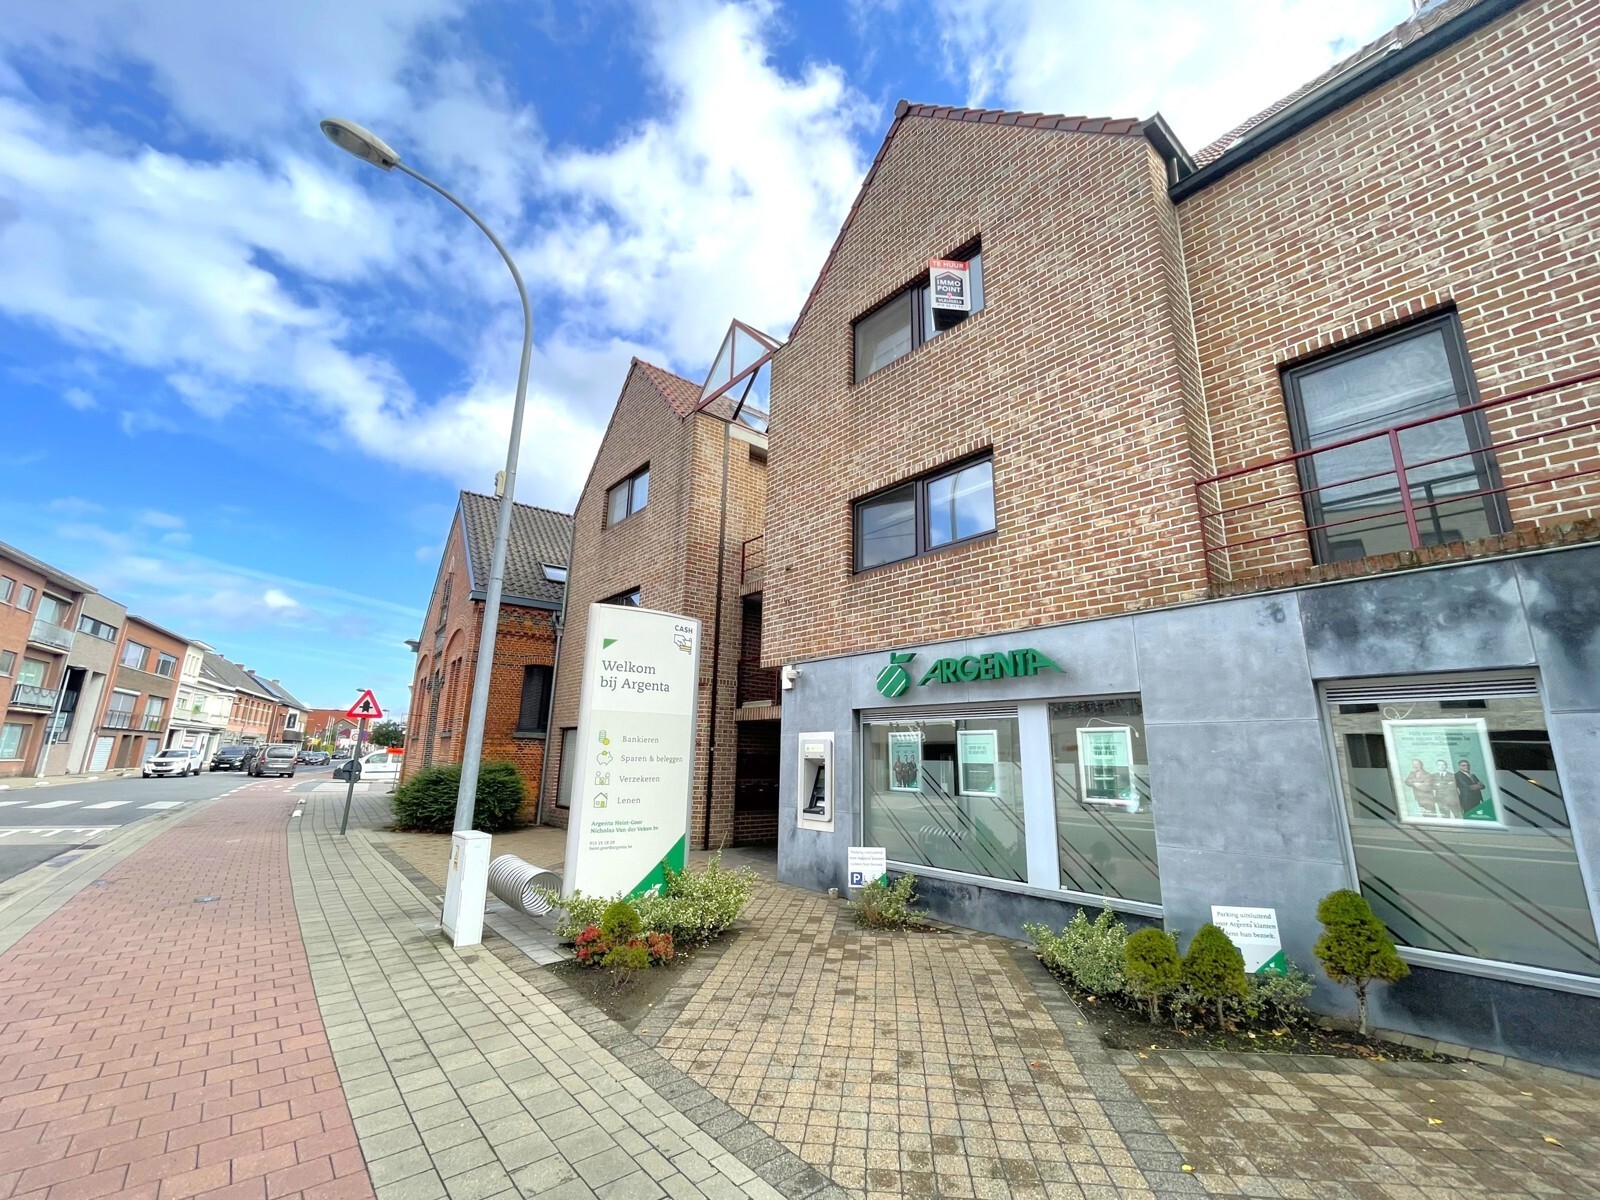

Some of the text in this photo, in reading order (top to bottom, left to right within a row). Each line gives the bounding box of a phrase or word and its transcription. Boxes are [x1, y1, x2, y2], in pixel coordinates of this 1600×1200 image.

[936, 279, 961, 287] IMMO
[674, 624, 693, 634] CASH
[602, 660, 656, 675] Welkom
[917, 648, 1067, 686] ARGENTA
[600, 676, 670, 693] bij Argenta
[622, 736, 659, 744] Bankieren
[620, 755, 647, 763] Sparen
[656, 755, 683, 764] beleggen
[1217, 911, 1239, 919] Parking
[1229, 921, 1253, 929] Argenta
[1253, 931, 1276, 939] bezoek.
